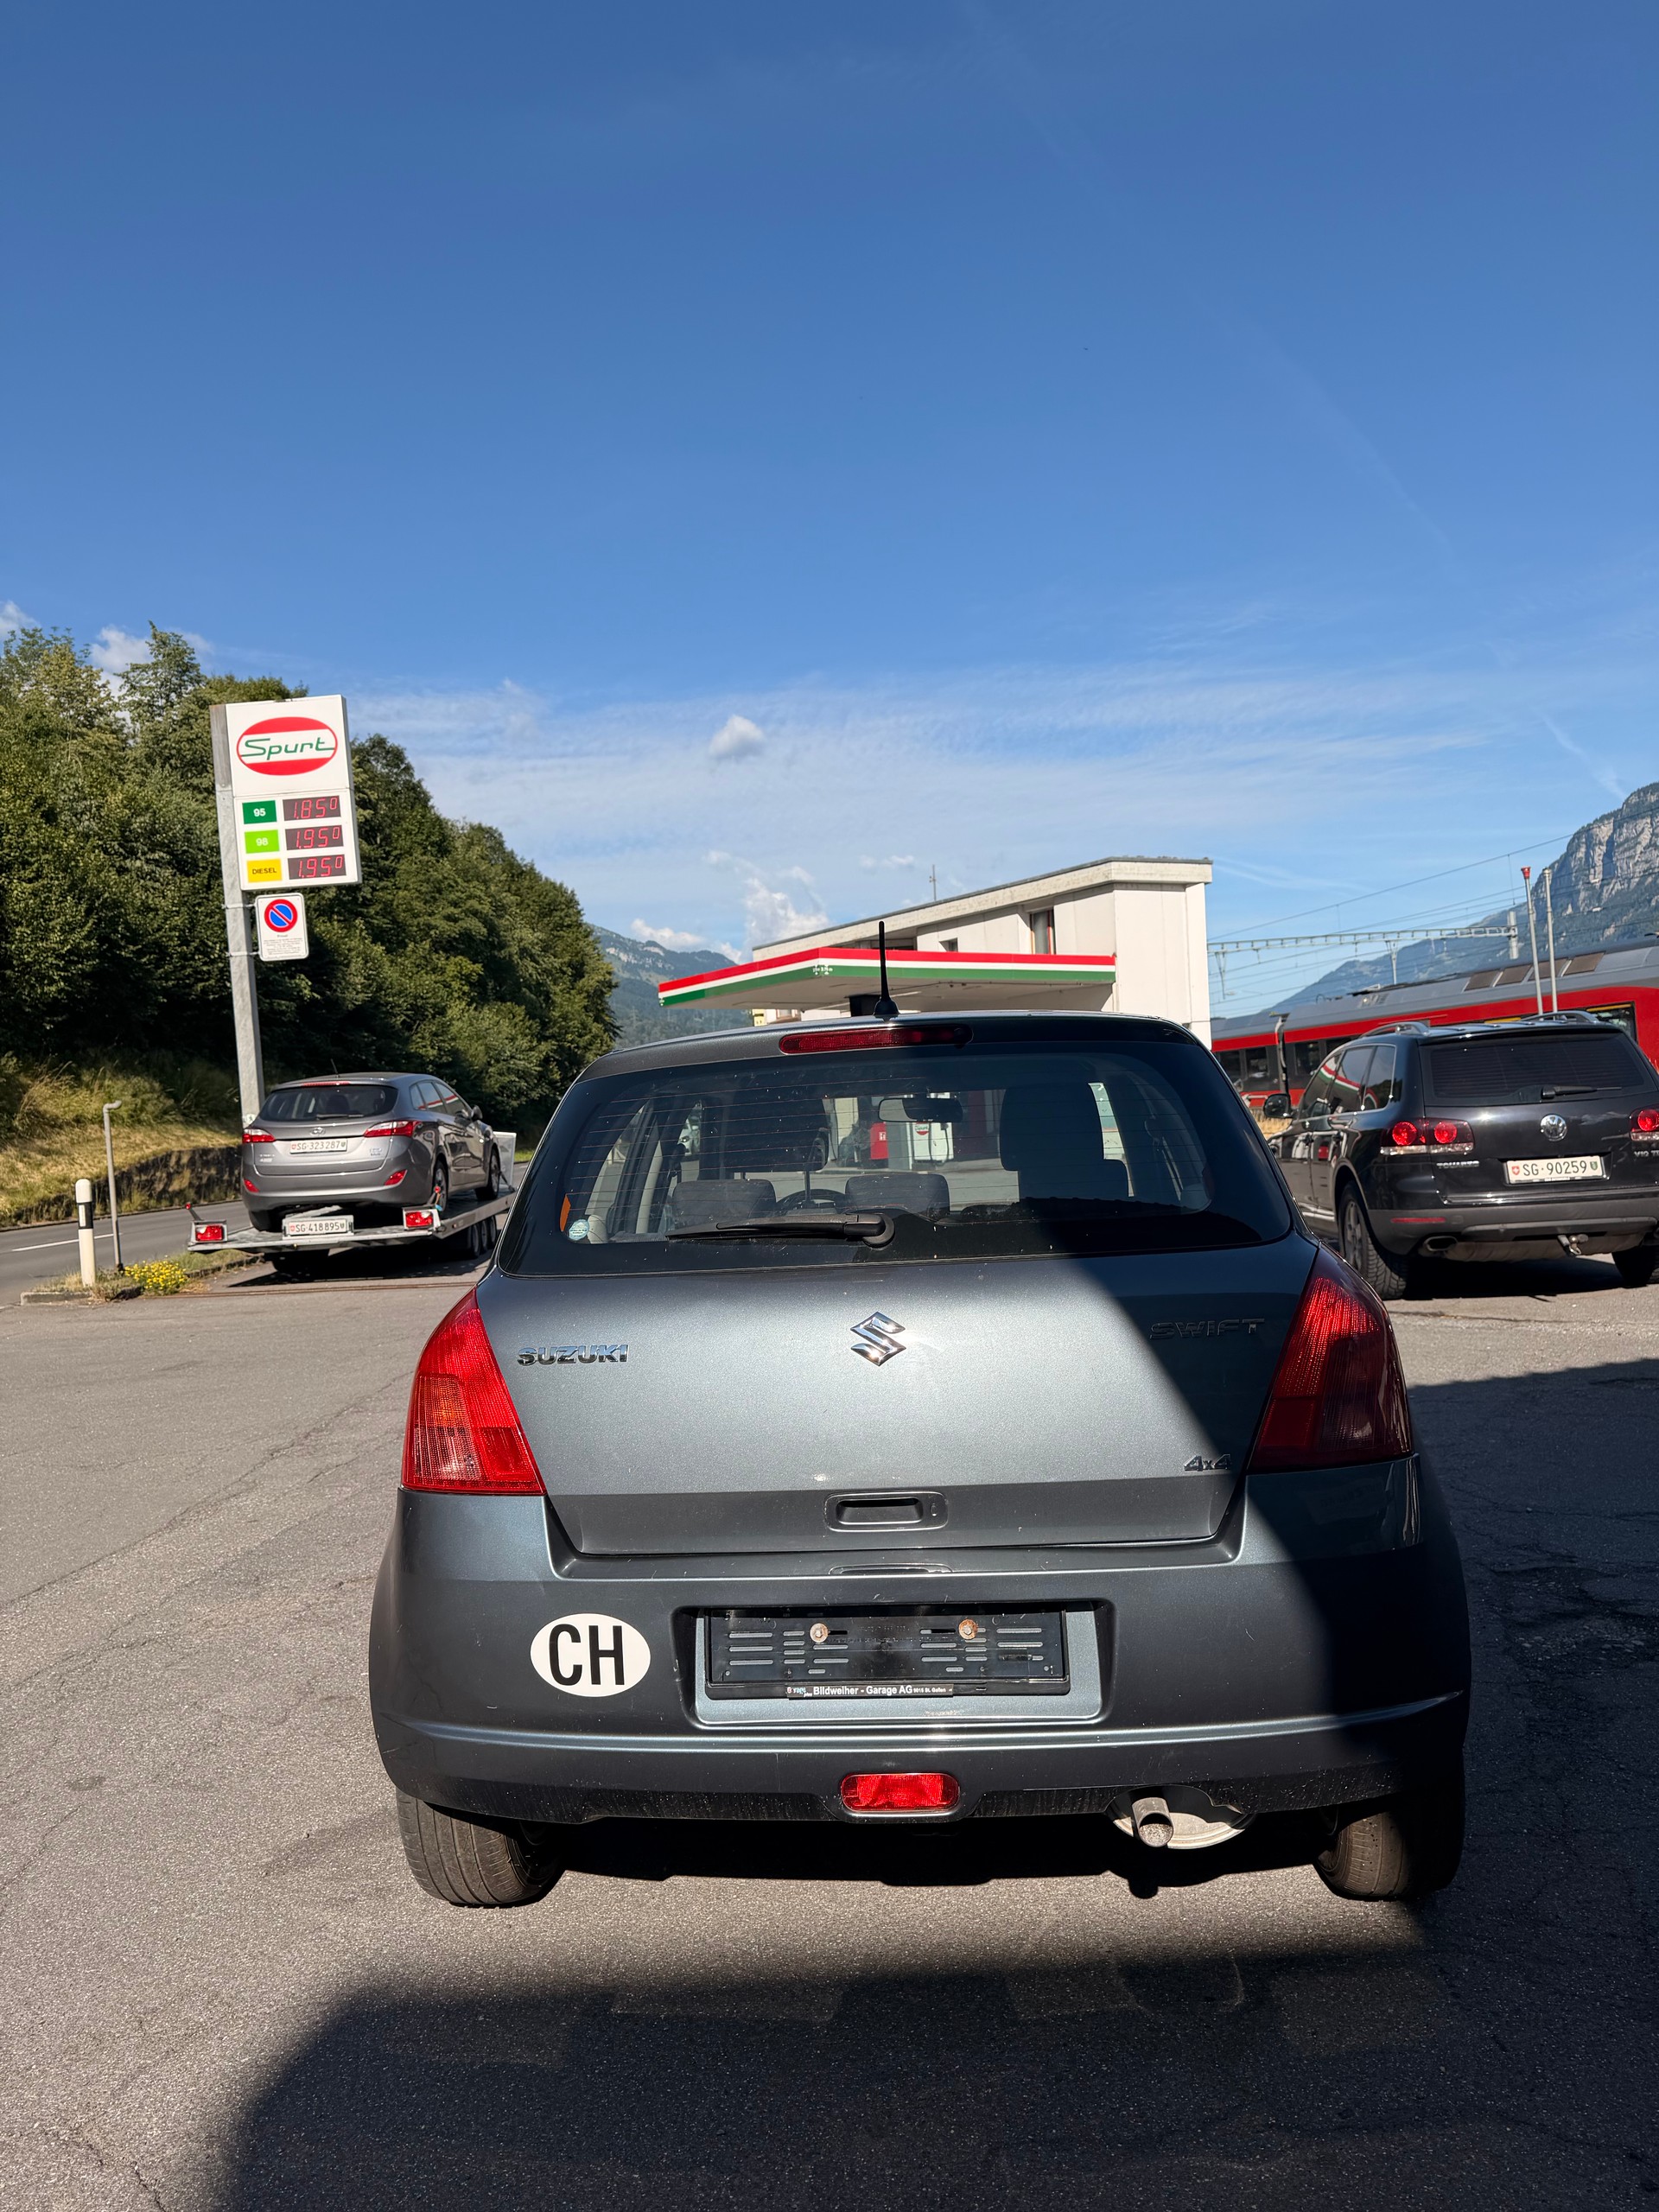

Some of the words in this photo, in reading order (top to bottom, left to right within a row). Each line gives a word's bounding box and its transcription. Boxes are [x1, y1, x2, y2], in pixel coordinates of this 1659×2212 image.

[240, 737, 334, 760] Spurt
[253, 808, 266, 817] 95
[256, 837, 269, 846] 98
[1150, 1318, 1265, 1339] SWIFT
[518, 1344, 629, 1366] SUZUKI
[549, 1624, 625, 1686] CH
[813, 1686, 859, 1695] Bildweiher
[866, 1685, 898, 1696] Garage
[899, 1685, 913, 1694] AG
